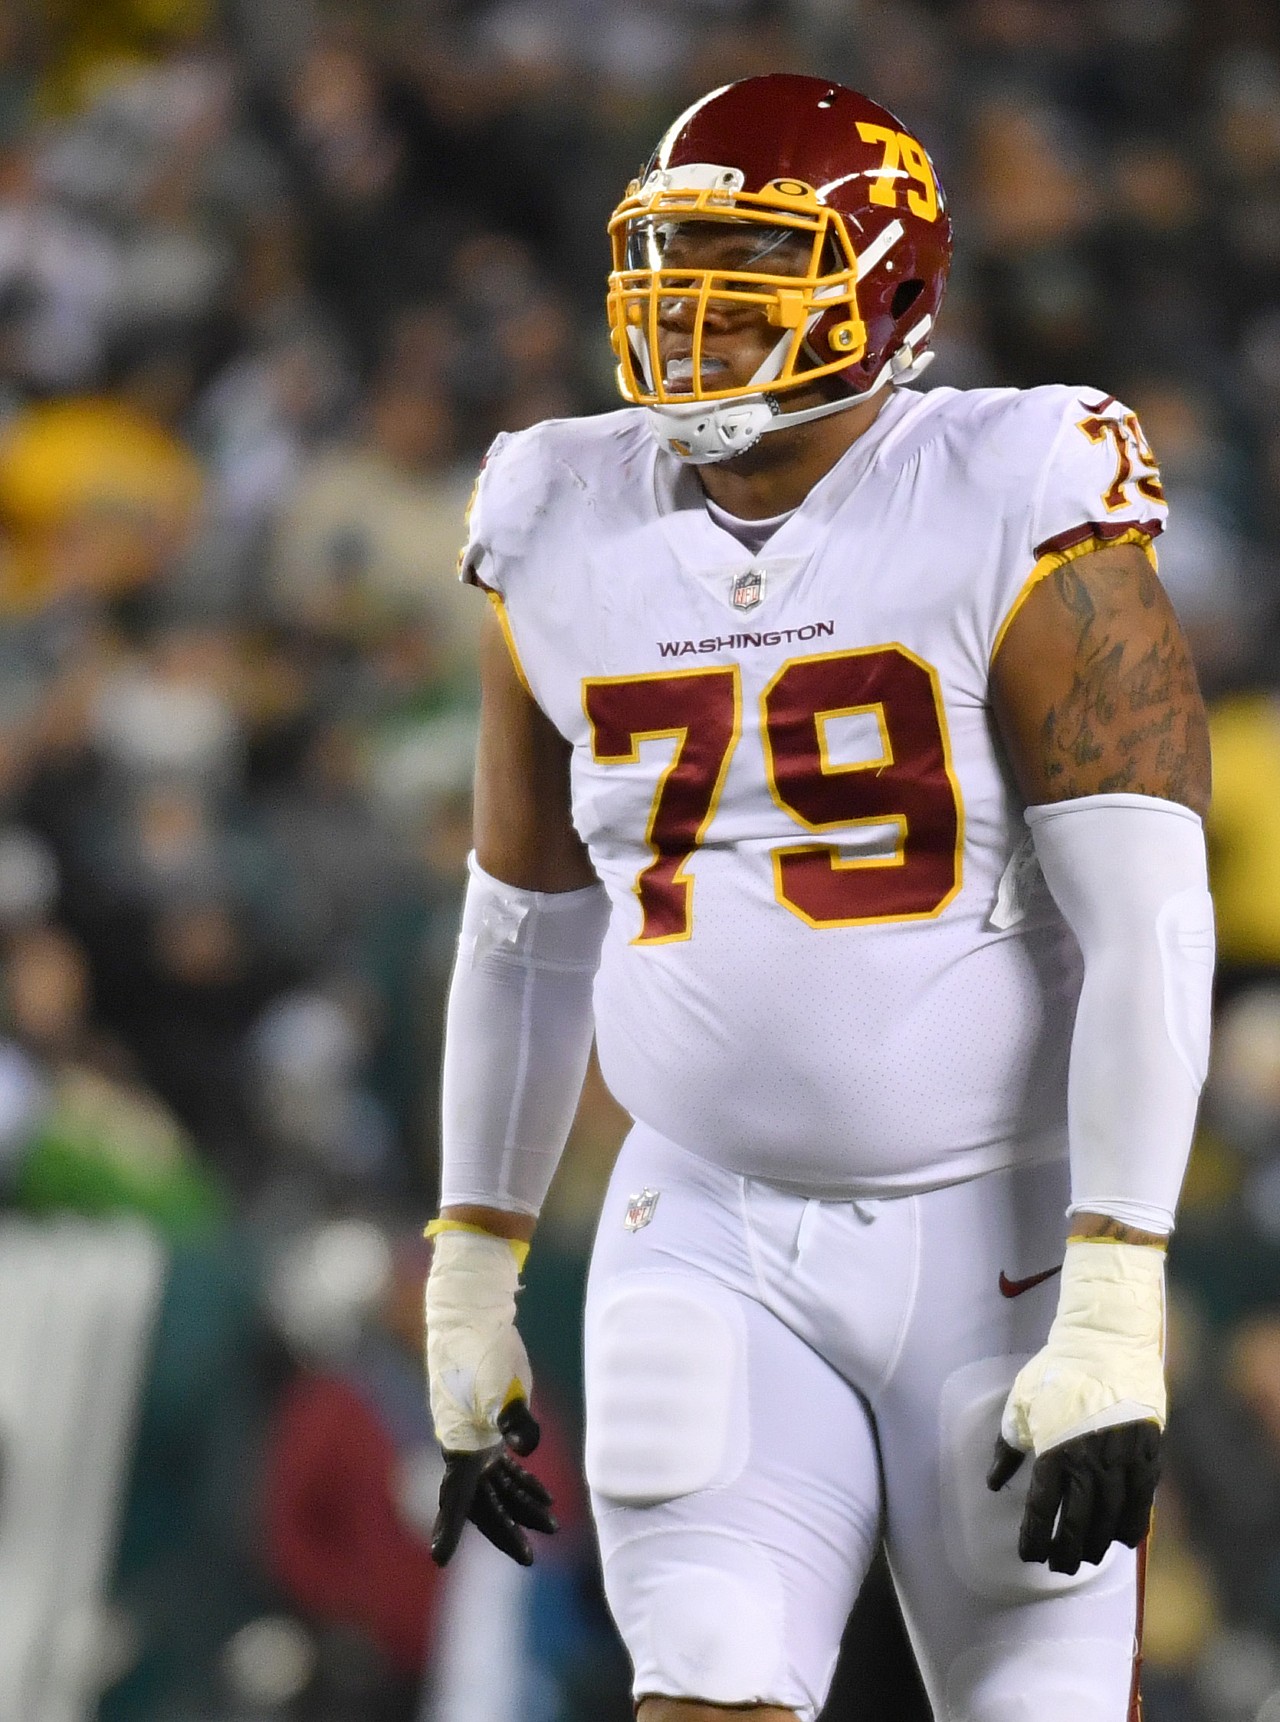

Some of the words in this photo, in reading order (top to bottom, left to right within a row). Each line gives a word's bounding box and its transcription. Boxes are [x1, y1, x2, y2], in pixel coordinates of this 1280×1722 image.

[854, 121, 937, 223] 79
[656, 620, 835, 658] WASHINGTON
[580, 641, 964, 946] 79
